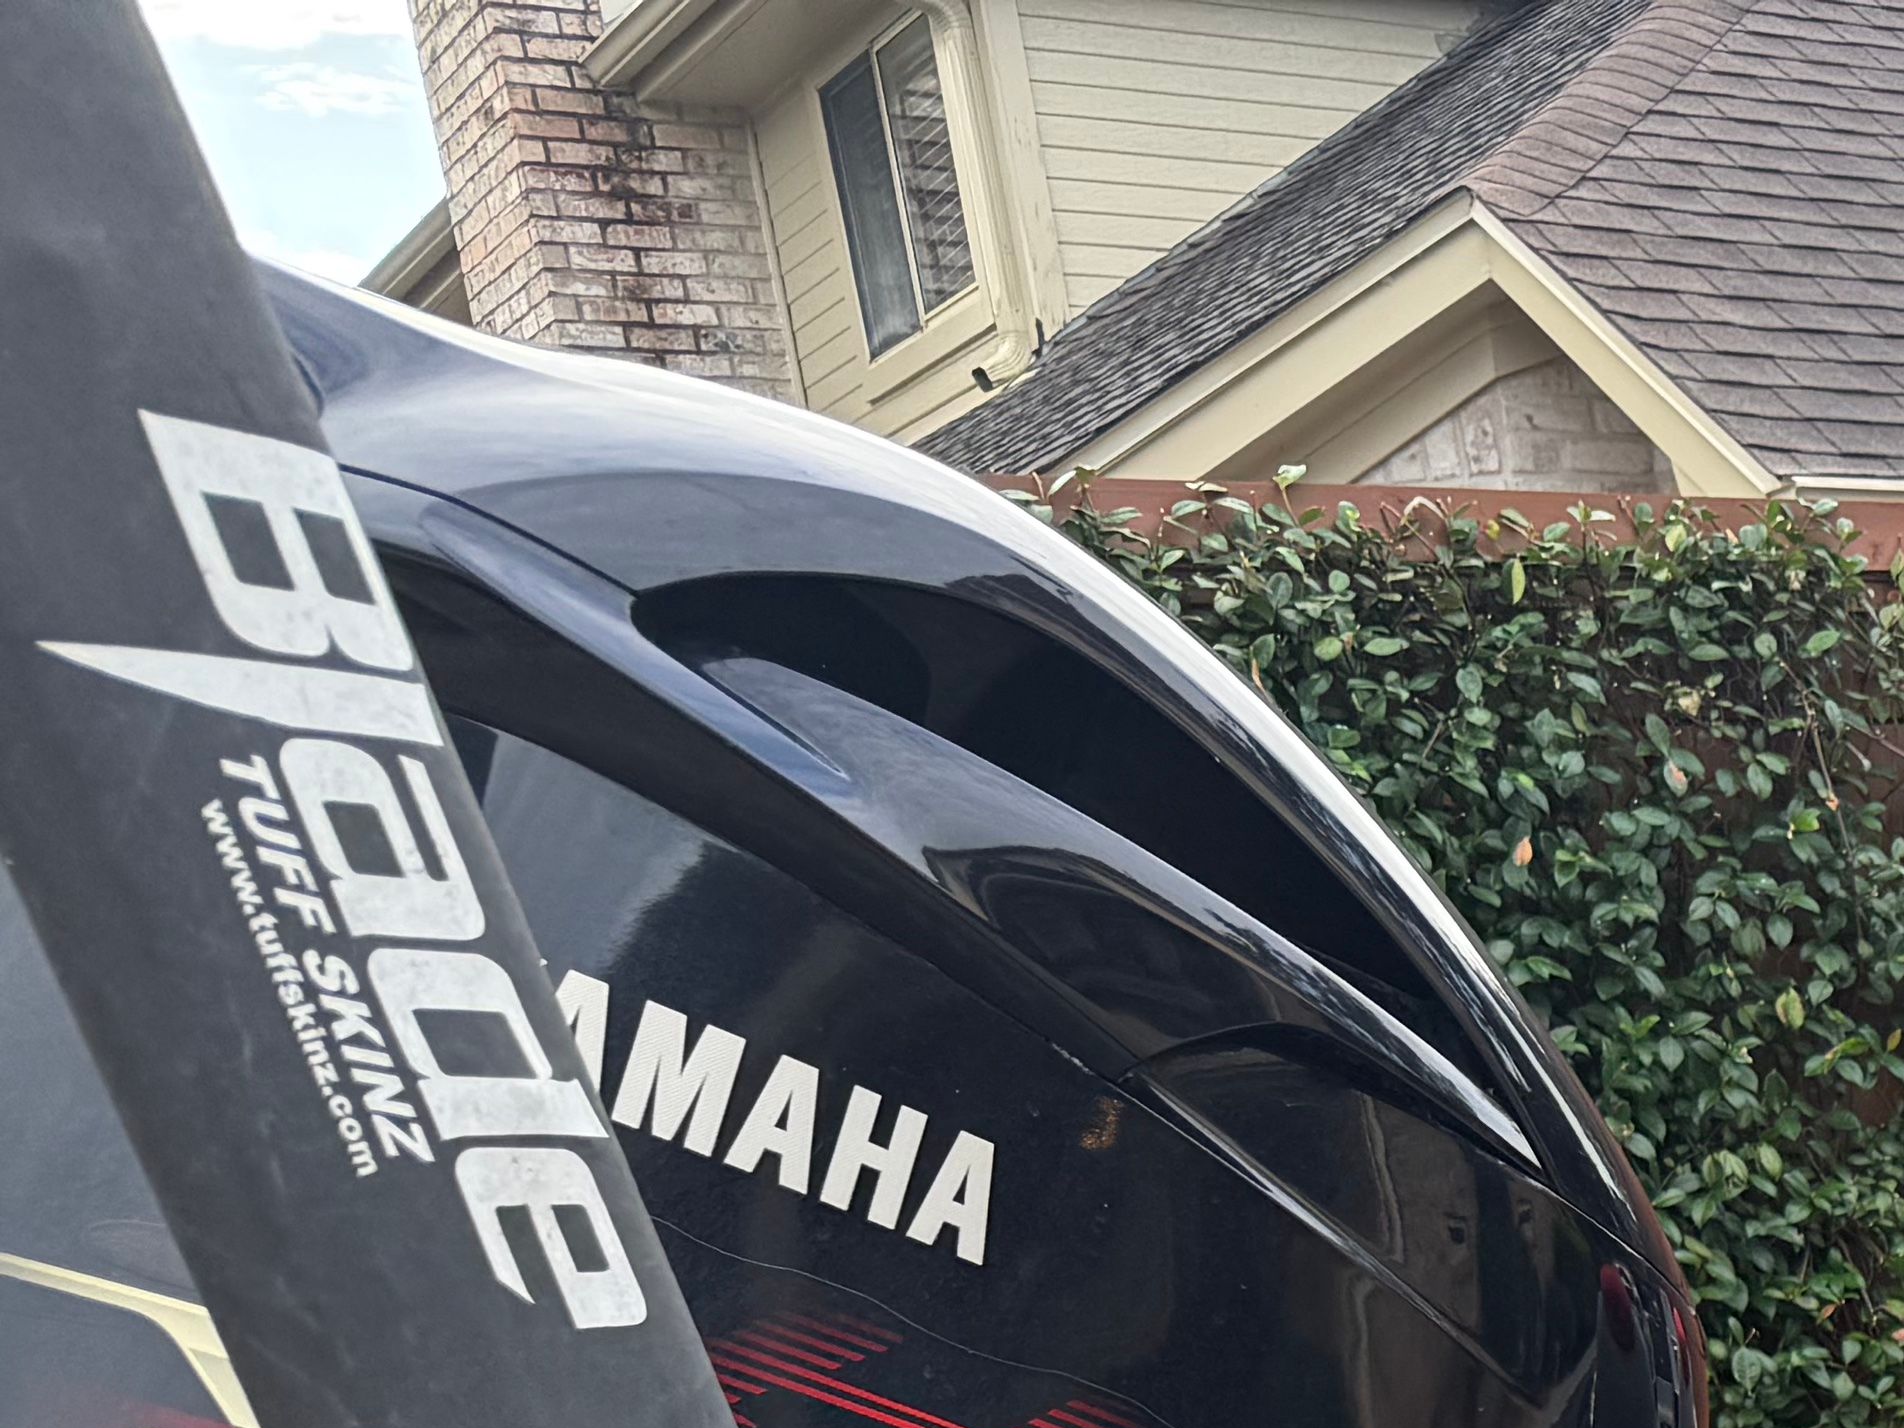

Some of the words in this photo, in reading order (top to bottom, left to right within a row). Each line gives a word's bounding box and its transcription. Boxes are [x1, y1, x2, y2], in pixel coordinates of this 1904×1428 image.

[36, 408, 648, 1330] Blade
[200, 798, 380, 1178] www.tuffskinz.com
[219, 754, 338, 935] TUFF
[302, 948, 437, 1163] SKINZ
[556, 968, 998, 1267] AMAHA
